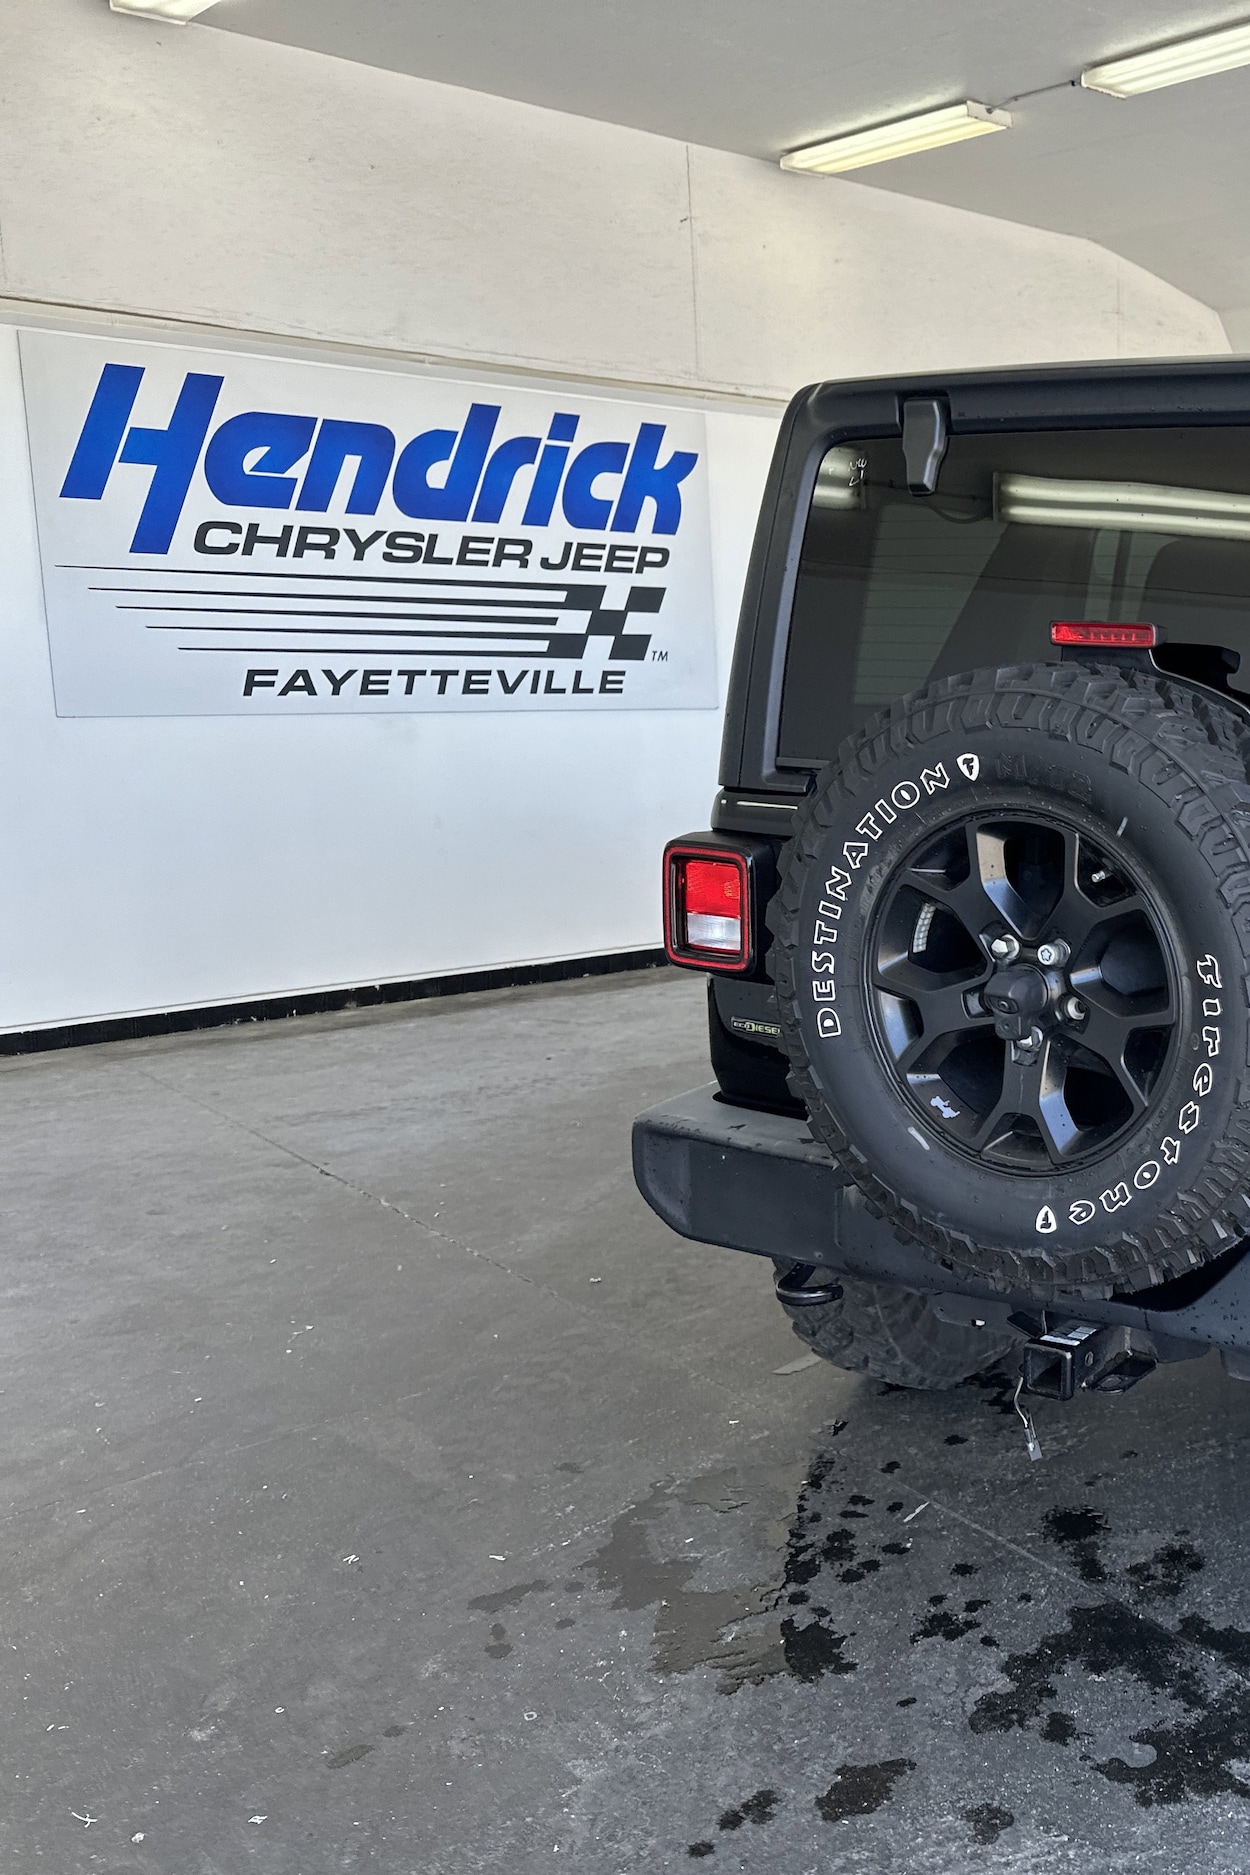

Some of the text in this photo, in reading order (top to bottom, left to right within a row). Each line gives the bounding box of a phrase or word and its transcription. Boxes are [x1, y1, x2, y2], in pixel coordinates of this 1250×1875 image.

[60, 363, 698, 555] Hendrick
[193, 520, 671, 574] CHRYSLER JEEP
[242, 669, 626, 697] FAYETTEVILLE
[652, 650, 669, 662] TM
[811, 762, 951, 1038] DESTINATION
[1068, 955, 1222, 1226] Firestone
